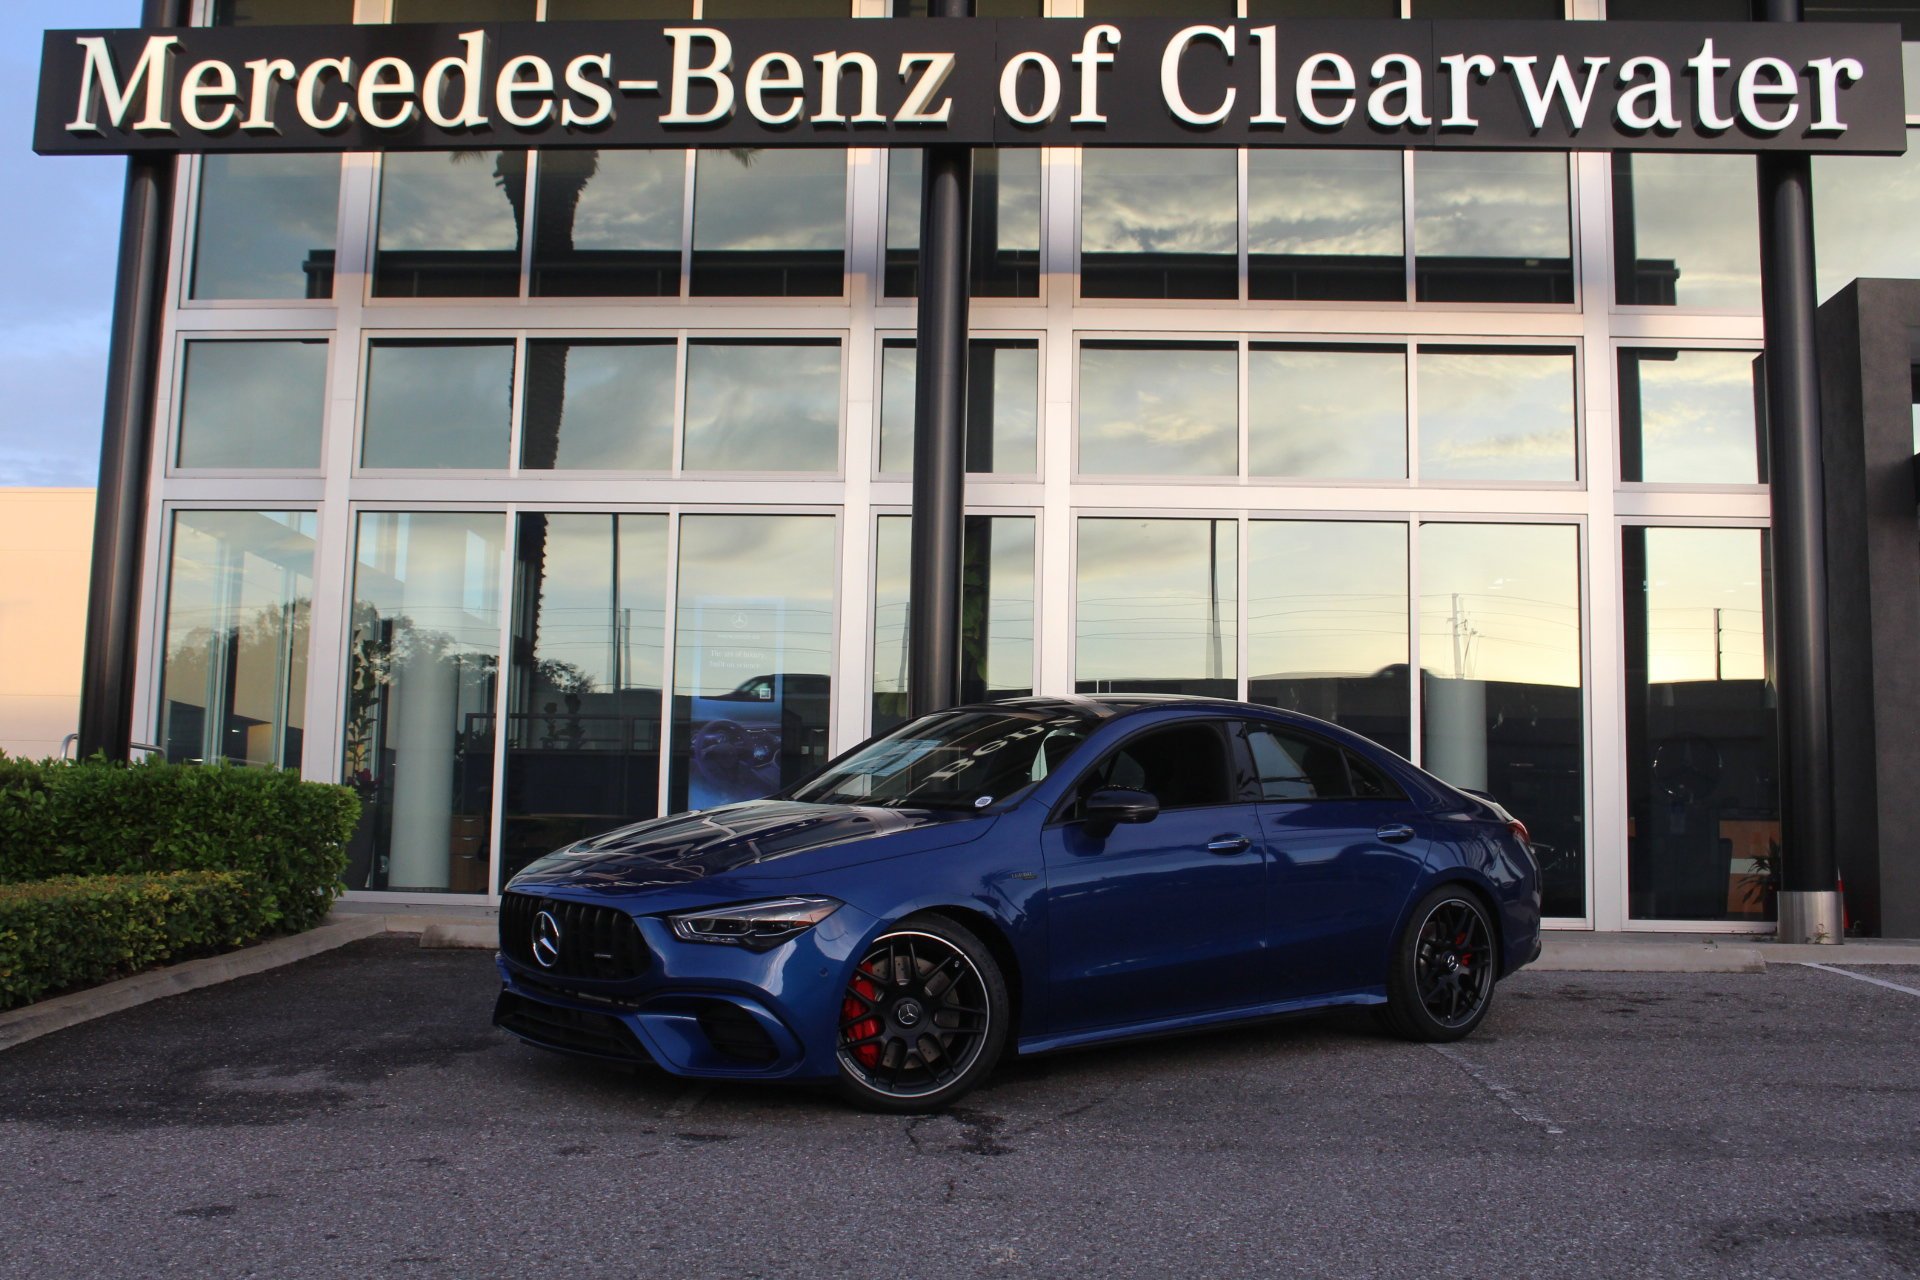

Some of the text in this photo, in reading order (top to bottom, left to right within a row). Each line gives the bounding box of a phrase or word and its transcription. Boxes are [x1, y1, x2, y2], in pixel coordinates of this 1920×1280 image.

[65, 24, 1864, 131] Mercedes-Benz of Clearwater
